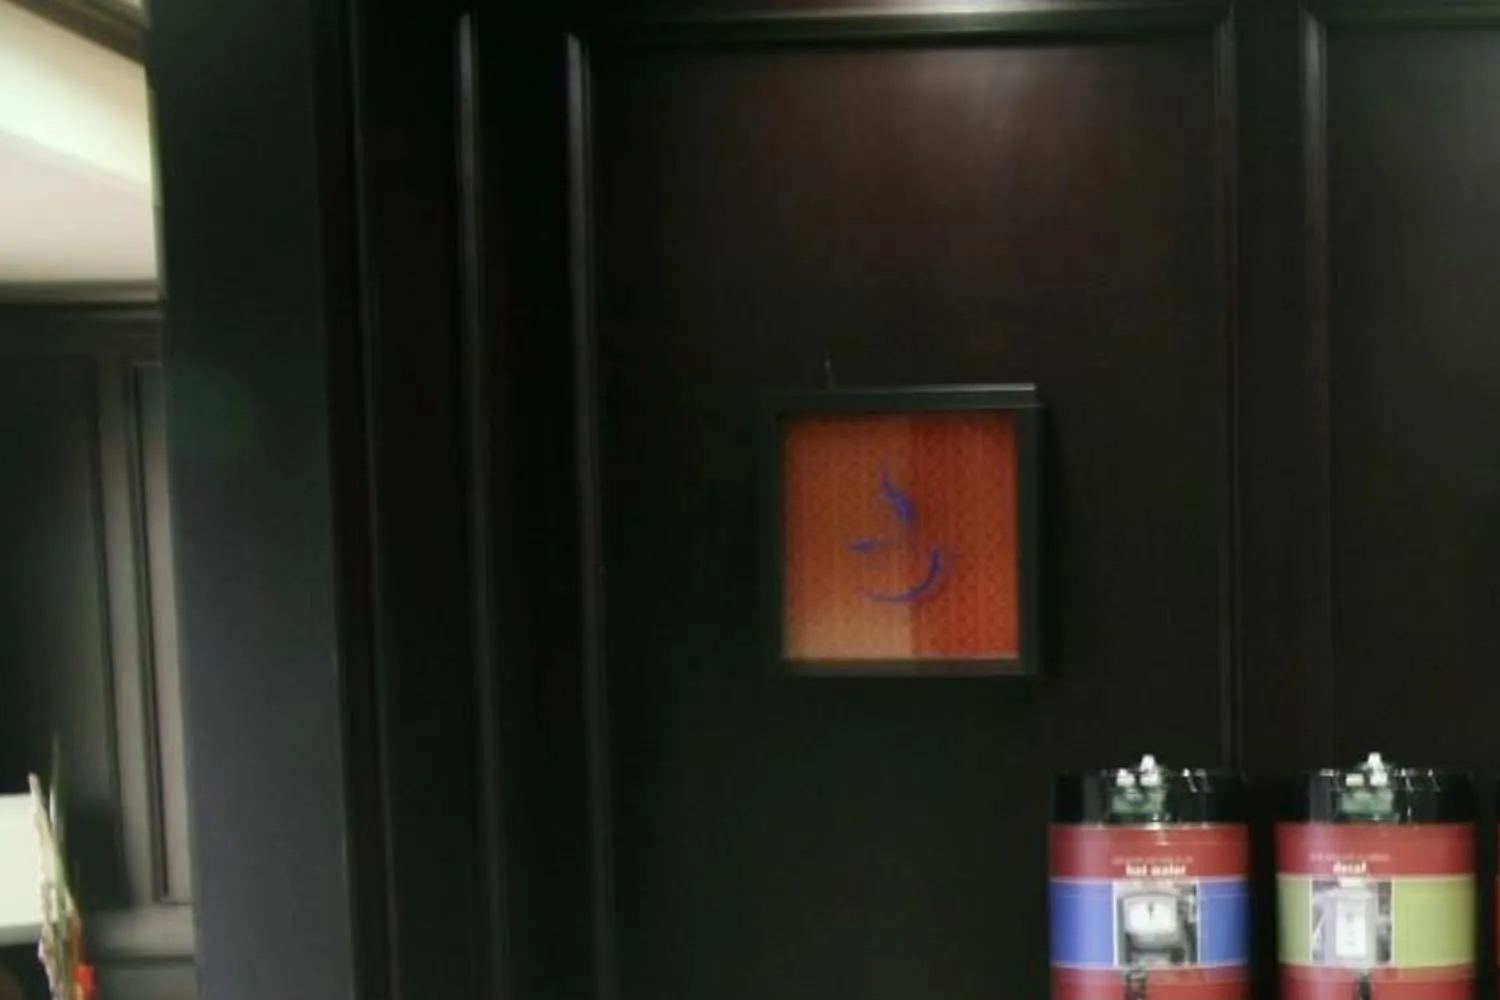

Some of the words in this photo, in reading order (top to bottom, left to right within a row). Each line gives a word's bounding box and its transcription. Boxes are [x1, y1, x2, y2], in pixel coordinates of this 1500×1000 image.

[1126, 862, 1147, 876] hot
[1151, 863, 1187, 876] water
[1332, 860, 1367, 874] decaf
